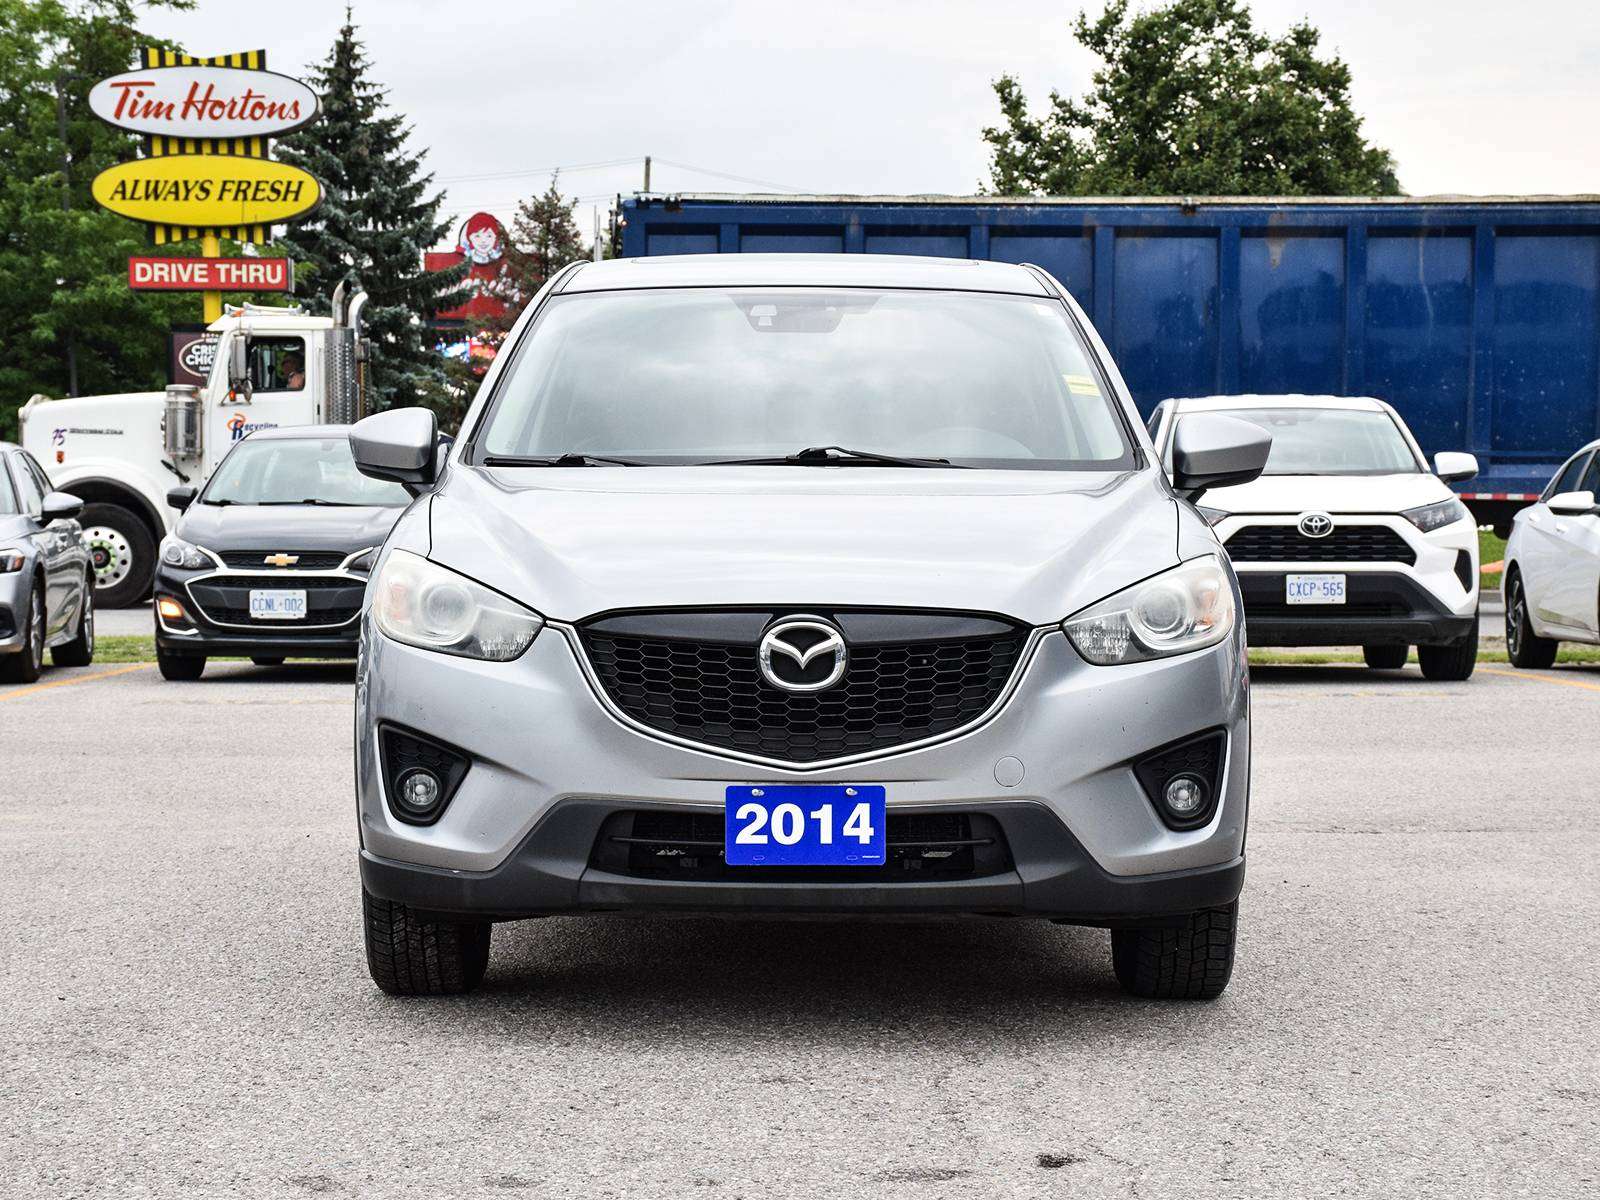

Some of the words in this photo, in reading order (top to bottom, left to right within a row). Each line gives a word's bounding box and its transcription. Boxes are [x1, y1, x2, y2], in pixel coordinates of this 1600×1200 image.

[110, 81, 176, 120] Tim
[180, 81, 301, 121] Hortons
[109, 179, 214, 201] ALWAYS
[217, 180, 305, 202] FRESH
[135, 262, 209, 283] DRIVE
[215, 263, 283, 285] THRU
[1289, 582, 1317, 596] CXCP
[1322, 582, 1344, 596] 565
[735, 802, 875, 846] 2014
